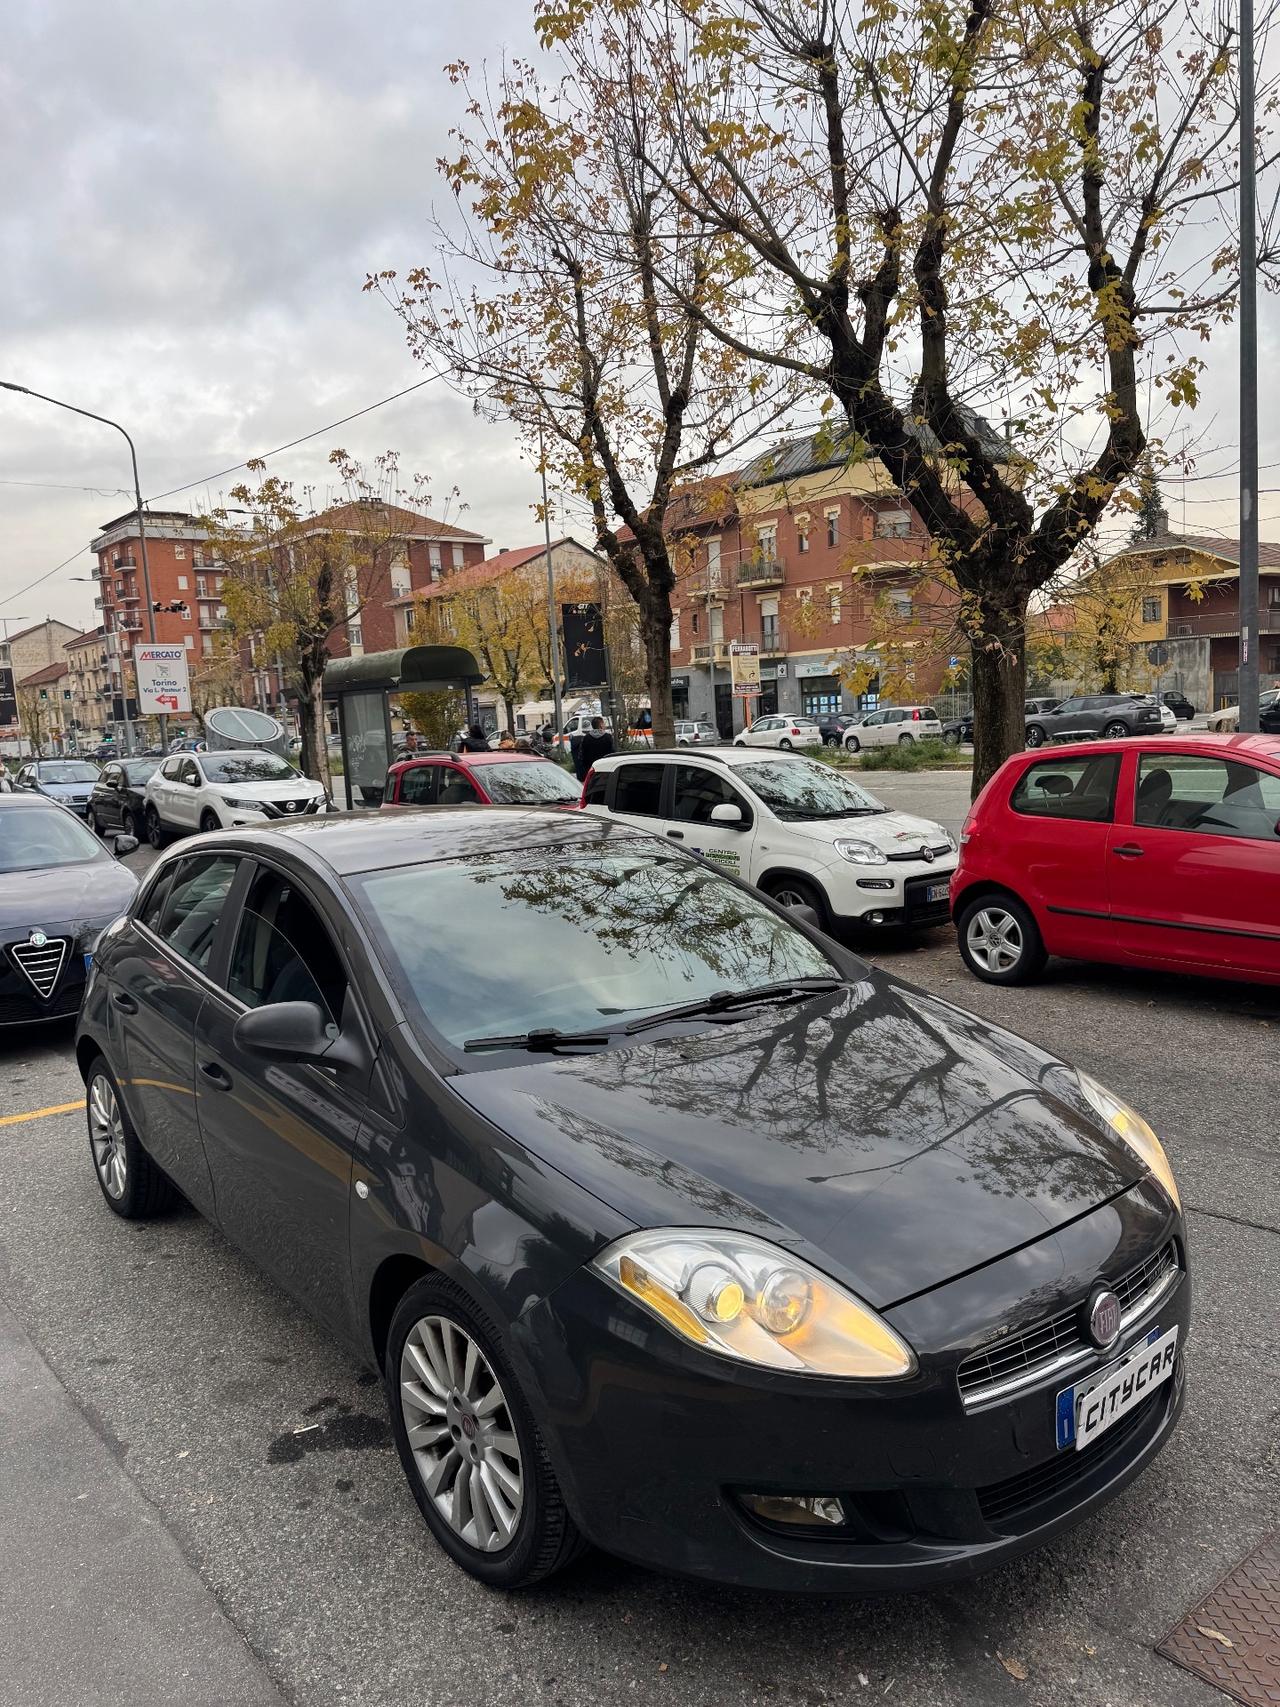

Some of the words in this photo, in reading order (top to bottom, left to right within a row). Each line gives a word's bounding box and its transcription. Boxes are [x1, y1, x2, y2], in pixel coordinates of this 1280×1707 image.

[140, 651, 181, 660] MERCATO
[1100, 1305, 1118, 1335] FIAT
[1086, 1342, 1175, 1432] CITYCAR
